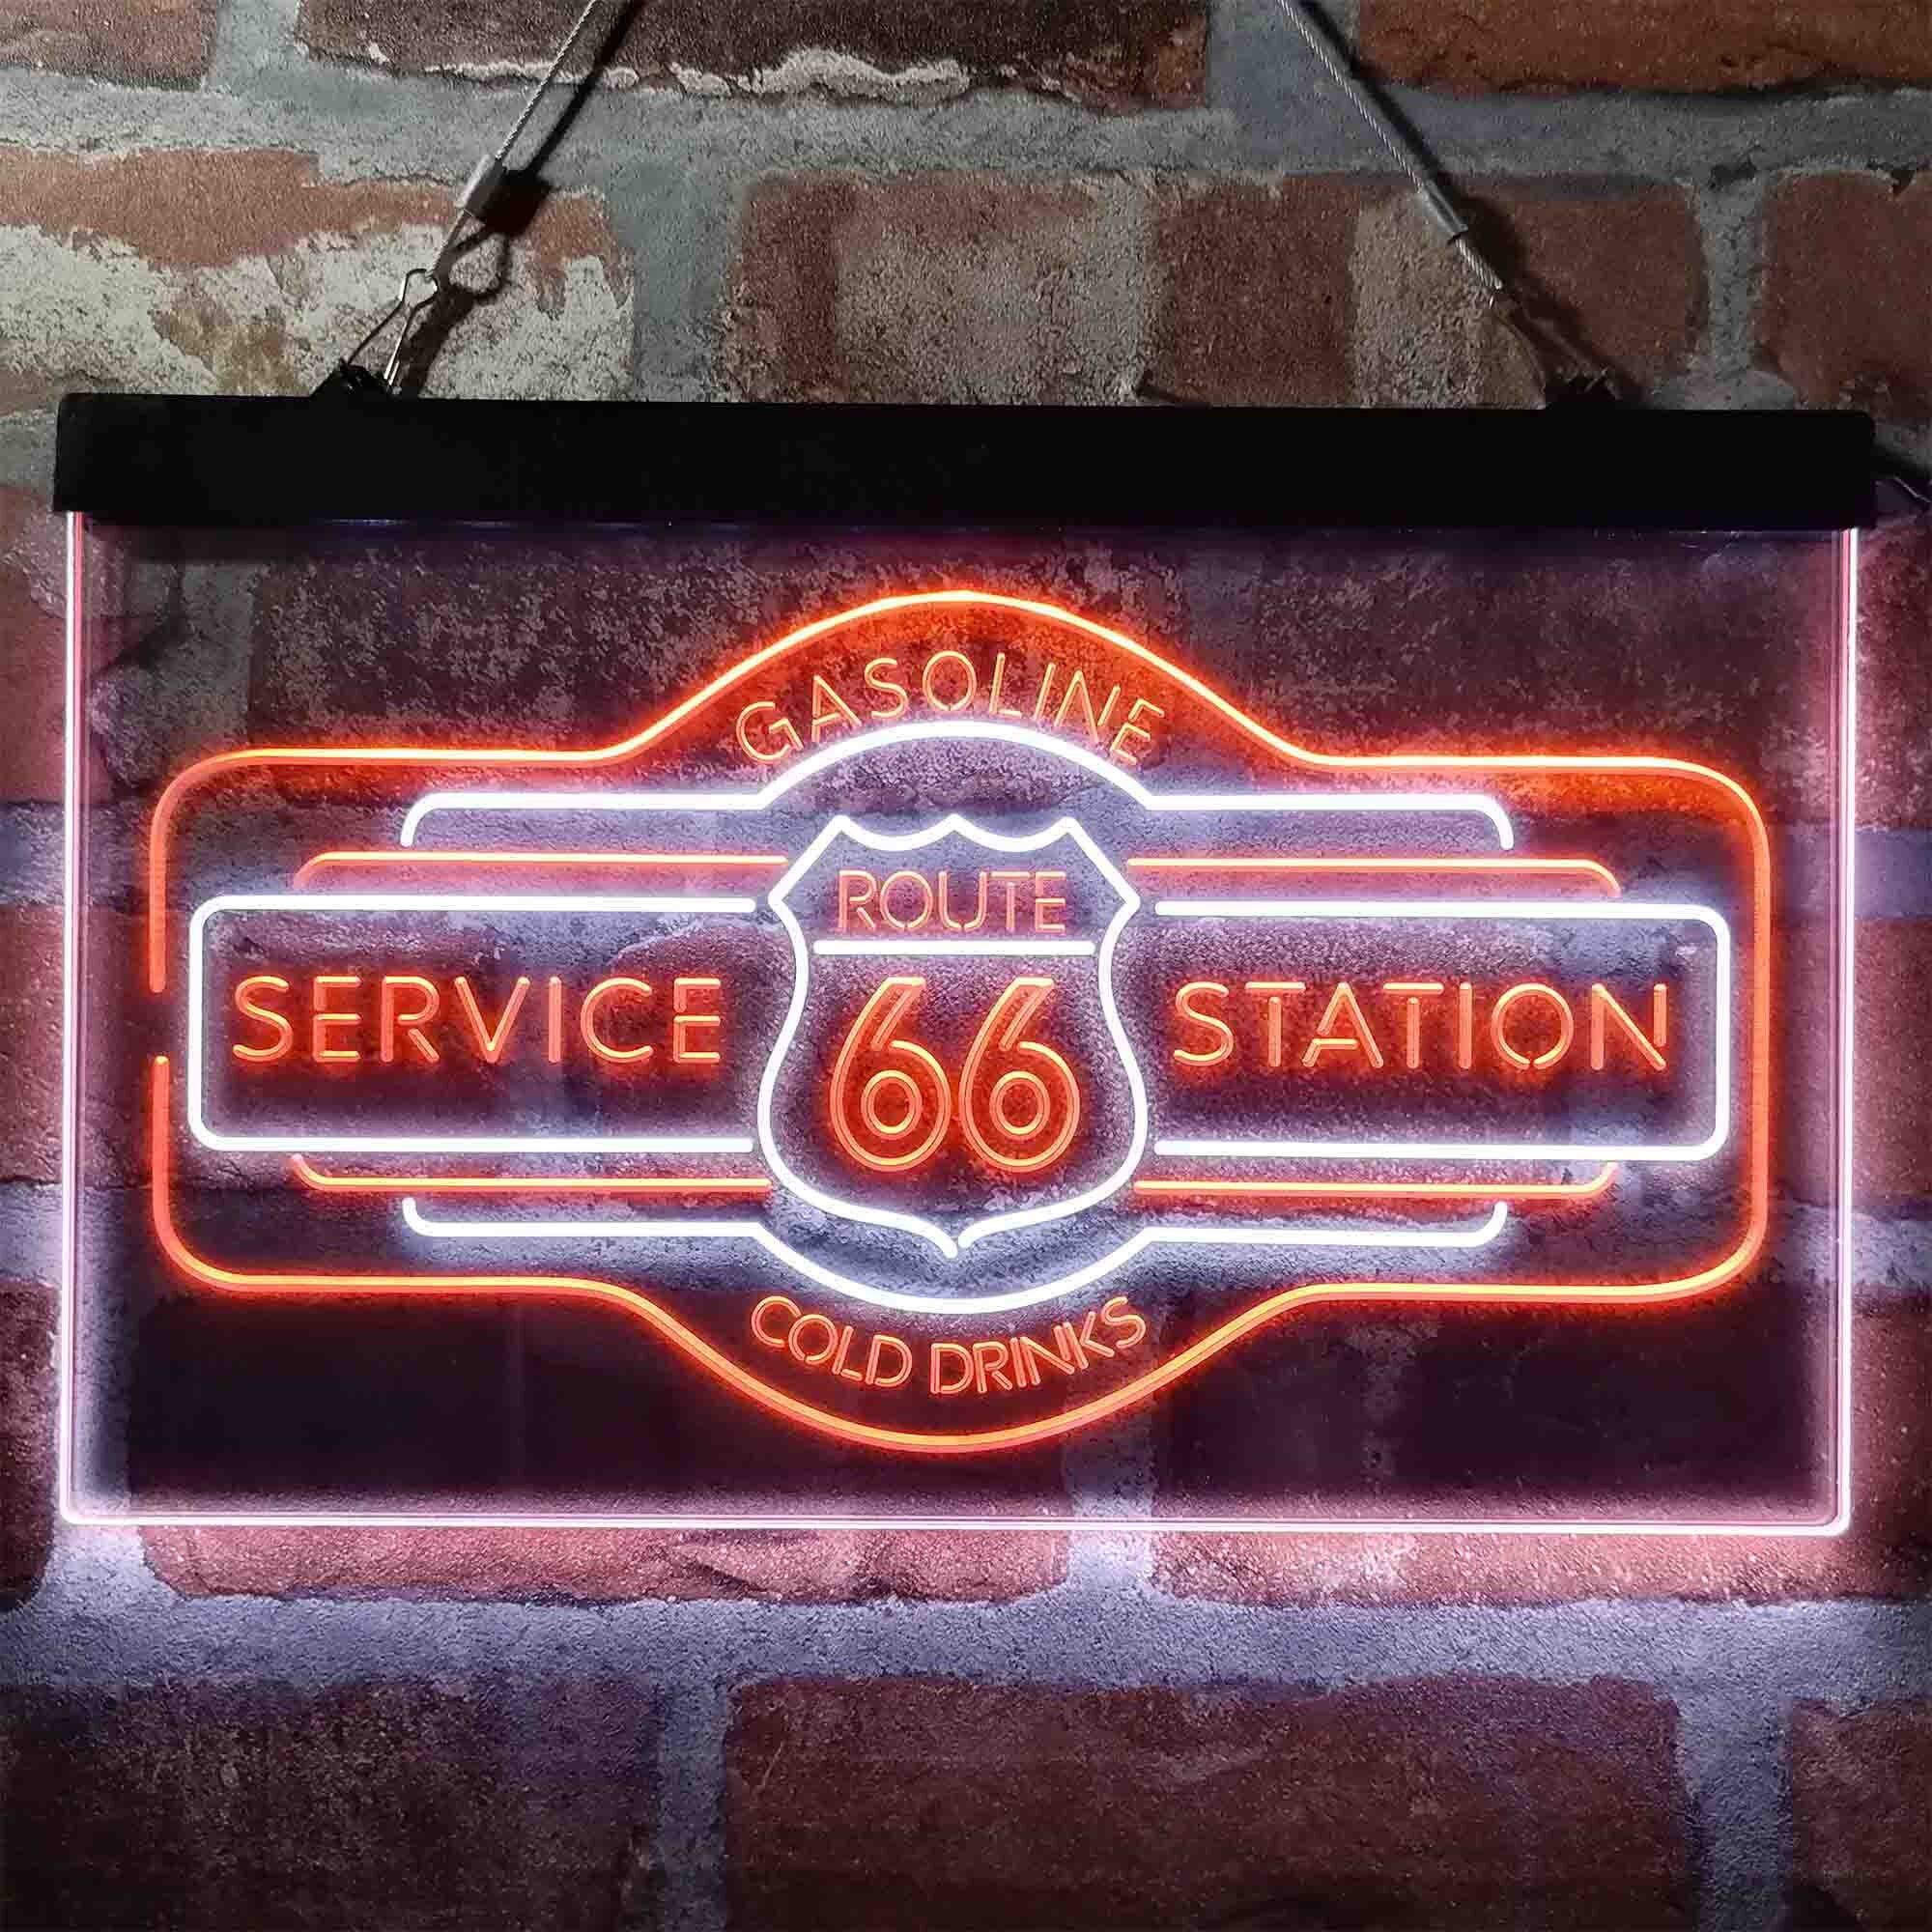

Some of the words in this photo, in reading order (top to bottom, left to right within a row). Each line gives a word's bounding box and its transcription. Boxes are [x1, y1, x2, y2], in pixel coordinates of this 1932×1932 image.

[735, 650, 1165, 764] GASOLINE
[838, 870, 1065, 933] ROUTE
[232, 975, 722, 1064] SERVICE
[1173, 980, 1668, 1069] STATION
[829, 977, 1081, 1173] 66
[751, 1295, 913, 1387] COLD
[930, 1295, 1148, 1395] DRINKS
